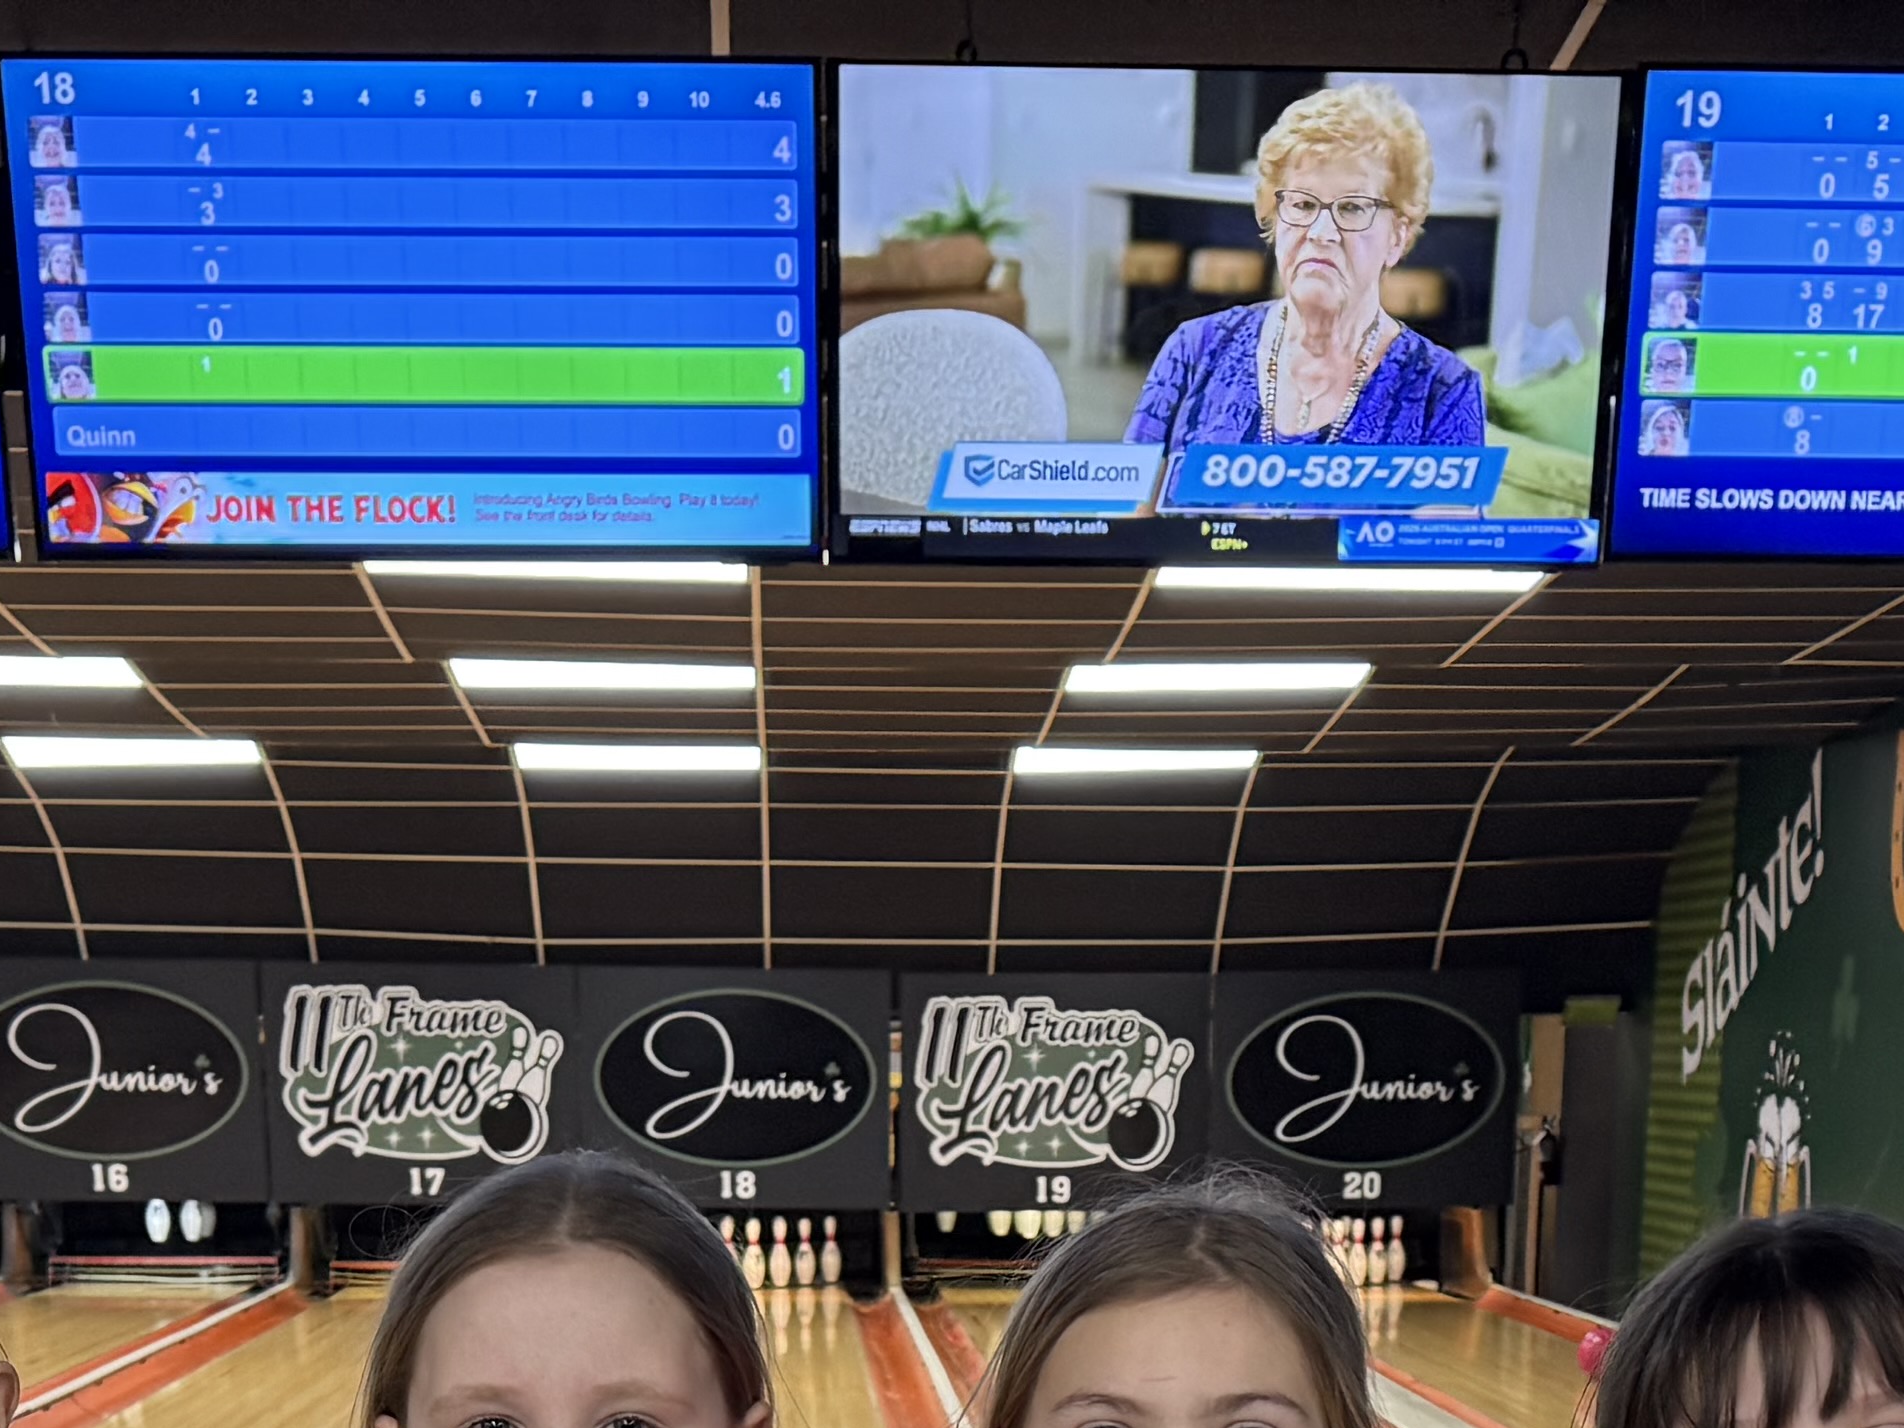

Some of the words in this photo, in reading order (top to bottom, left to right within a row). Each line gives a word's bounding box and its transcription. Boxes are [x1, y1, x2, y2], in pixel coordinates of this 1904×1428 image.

[33, 72, 75, 105] 18
[1675, 89, 1722, 127] 19
[772, 136, 792, 164] 4
[773, 194, 792, 222] 3
[774, 253, 793, 281] 0
[775, 311, 794, 338] 0
[776, 367, 792, 394] 1
[66, 424, 136, 450] Quinn
[776, 424, 795, 452] 0
[997, 458, 1140, 483] CarShield.com
[1202, 454, 1481, 490] 800-587-7951
[206, 494, 276, 523] JOIN
[286, 494, 344, 523] THE
[354, 494, 456, 523] FLOCK!
[586, 493, 617, 505] Birds
[679, 493, 705, 508] Play
[1640, 488, 1692, 508] TIME
[1695, 488, 1774, 509] SLOWS
[1778, 489, 1847, 510] DOWN
[503, 510, 523, 521] the
[378, 986, 507, 1036] Frame
[1014, 996, 1140, 1047] Frame
[298, 1028, 502, 1157] Lanes
[930, 1040, 1132, 1166] Lanes
[92, 1163, 129, 1192] 16
[409, 1167, 446, 1196] 17
[720, 1170, 756, 1200] 18
[1035, 1176, 1071, 1204] 19
[1342, 1171, 1382, 1199] 20
